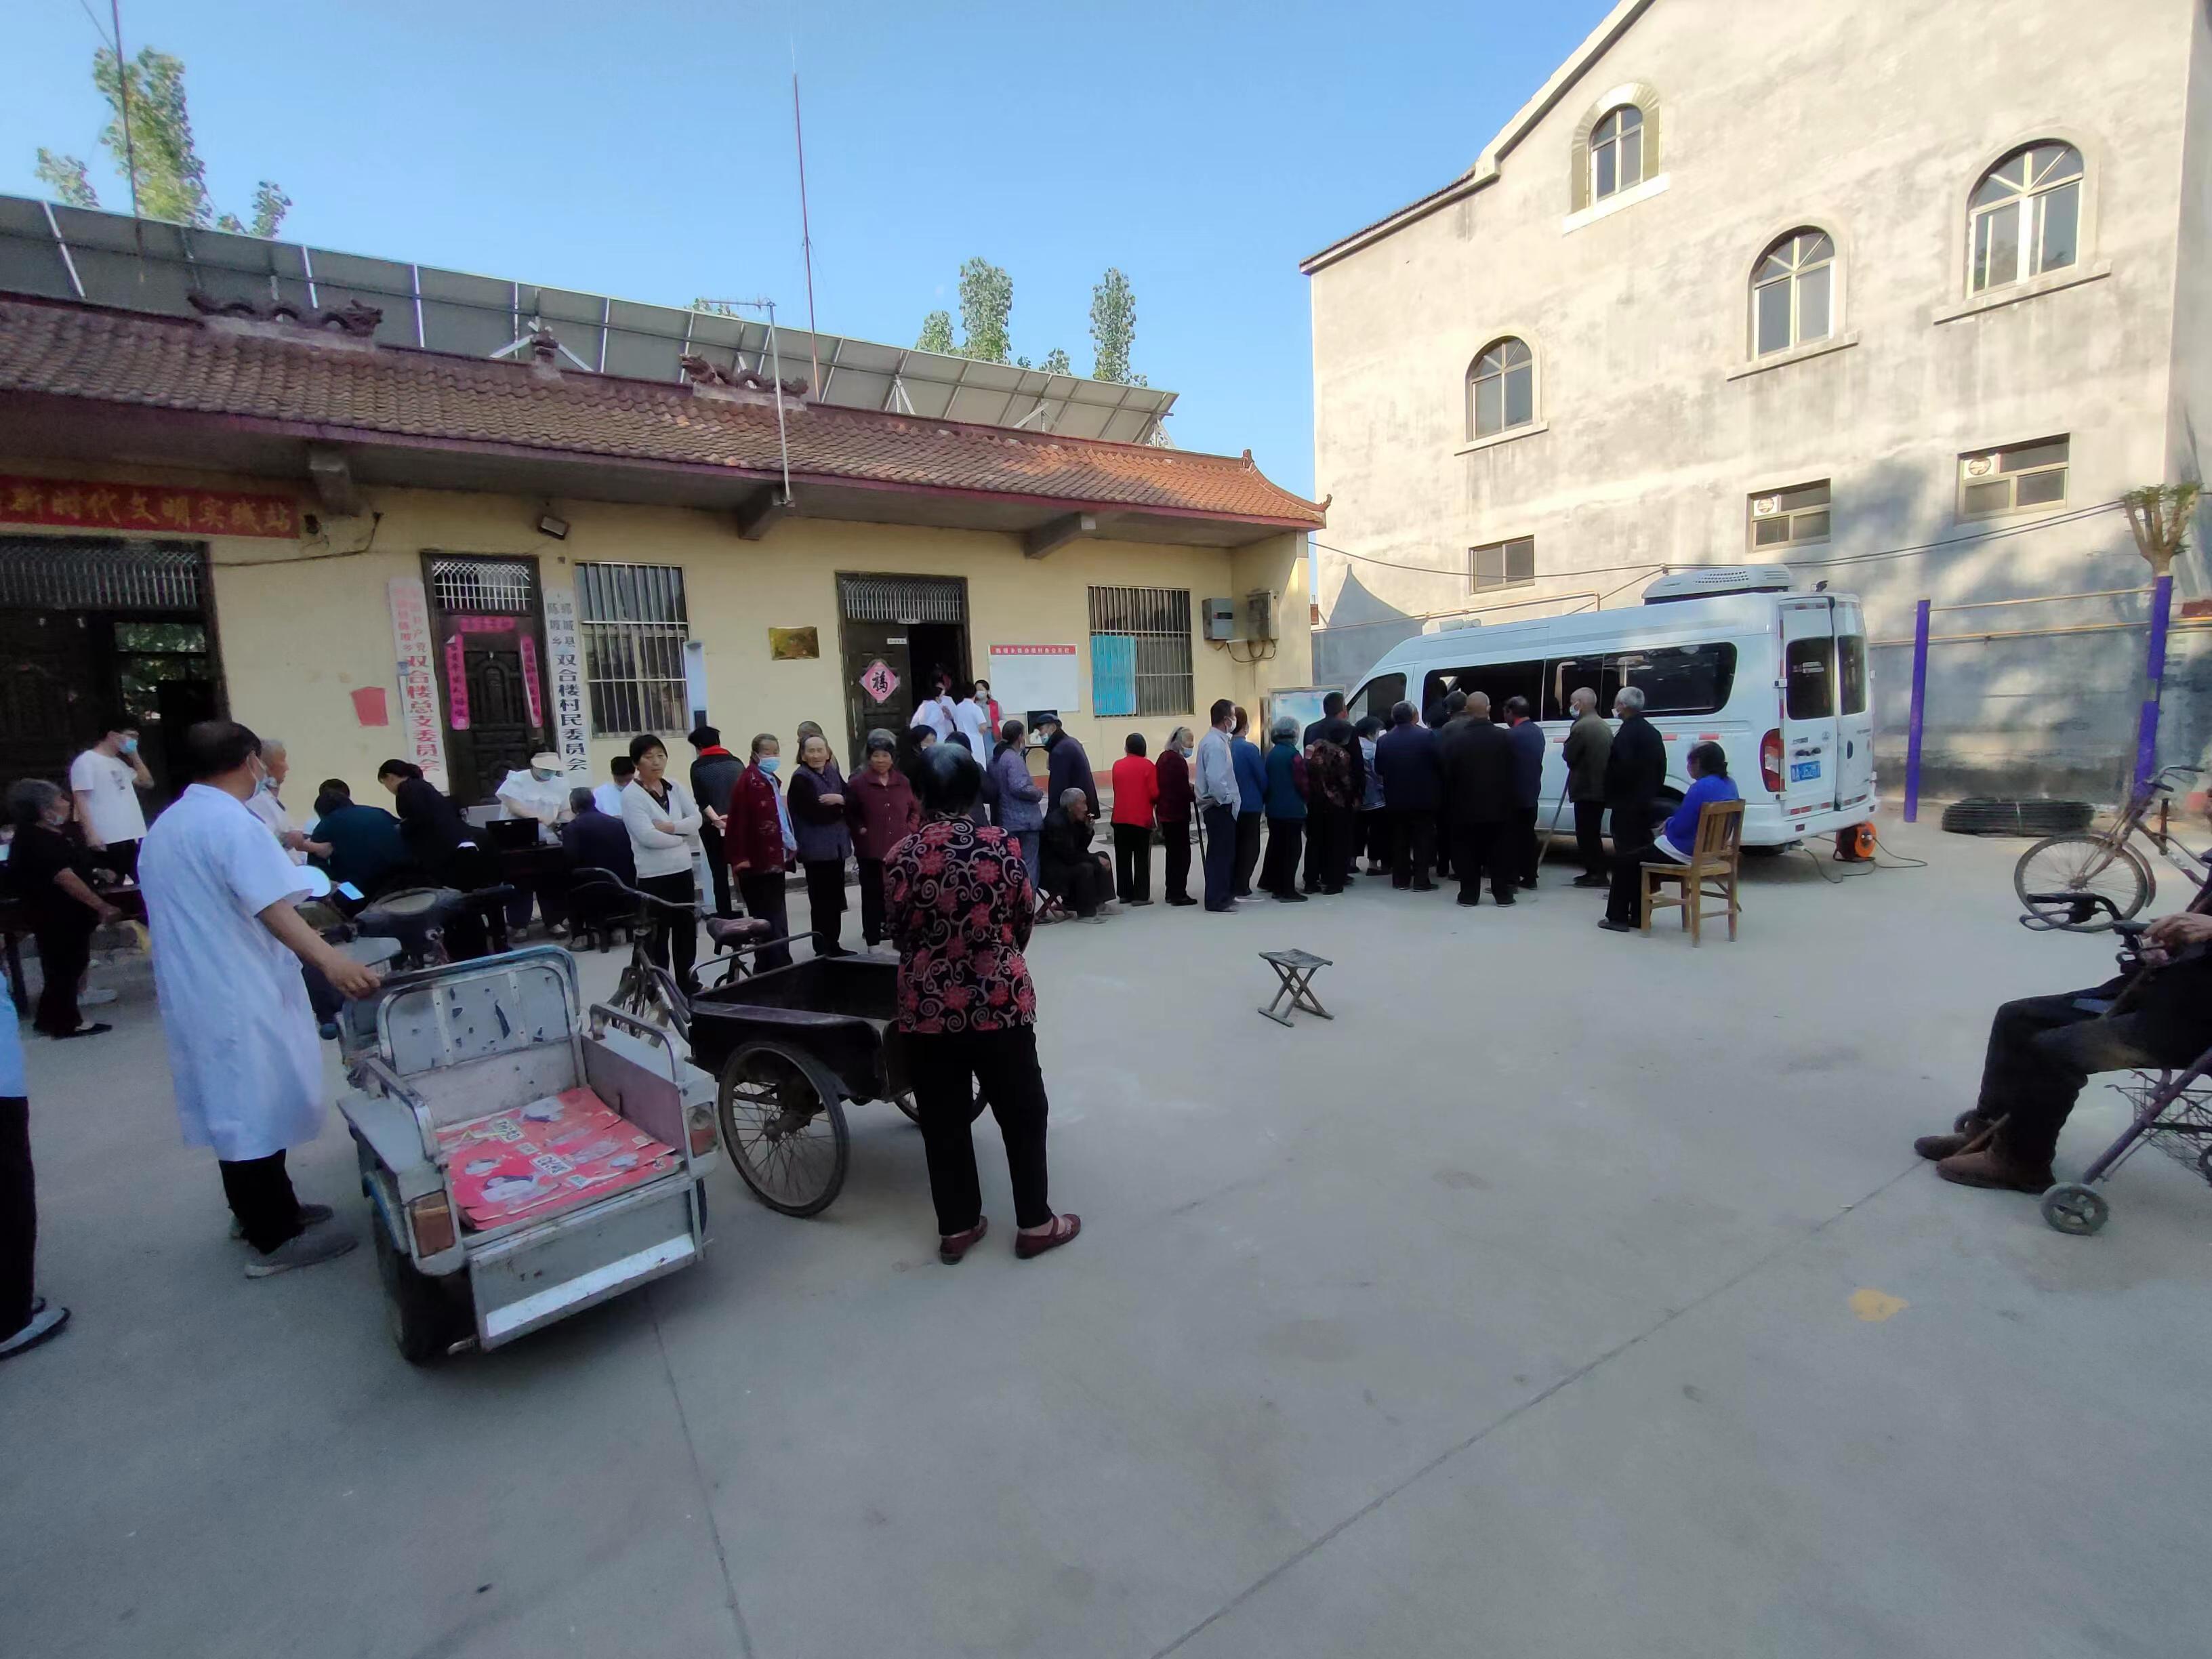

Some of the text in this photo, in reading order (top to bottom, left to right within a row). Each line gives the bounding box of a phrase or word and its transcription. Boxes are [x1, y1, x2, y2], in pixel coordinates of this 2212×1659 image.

[0, 485, 291, 533] 新时代文明实践站
[406, 655, 441, 772] 双合楼总支委员会
[557, 654, 588, 771] 双合楼村民委员会
[872, 670, 888, 693] 福
